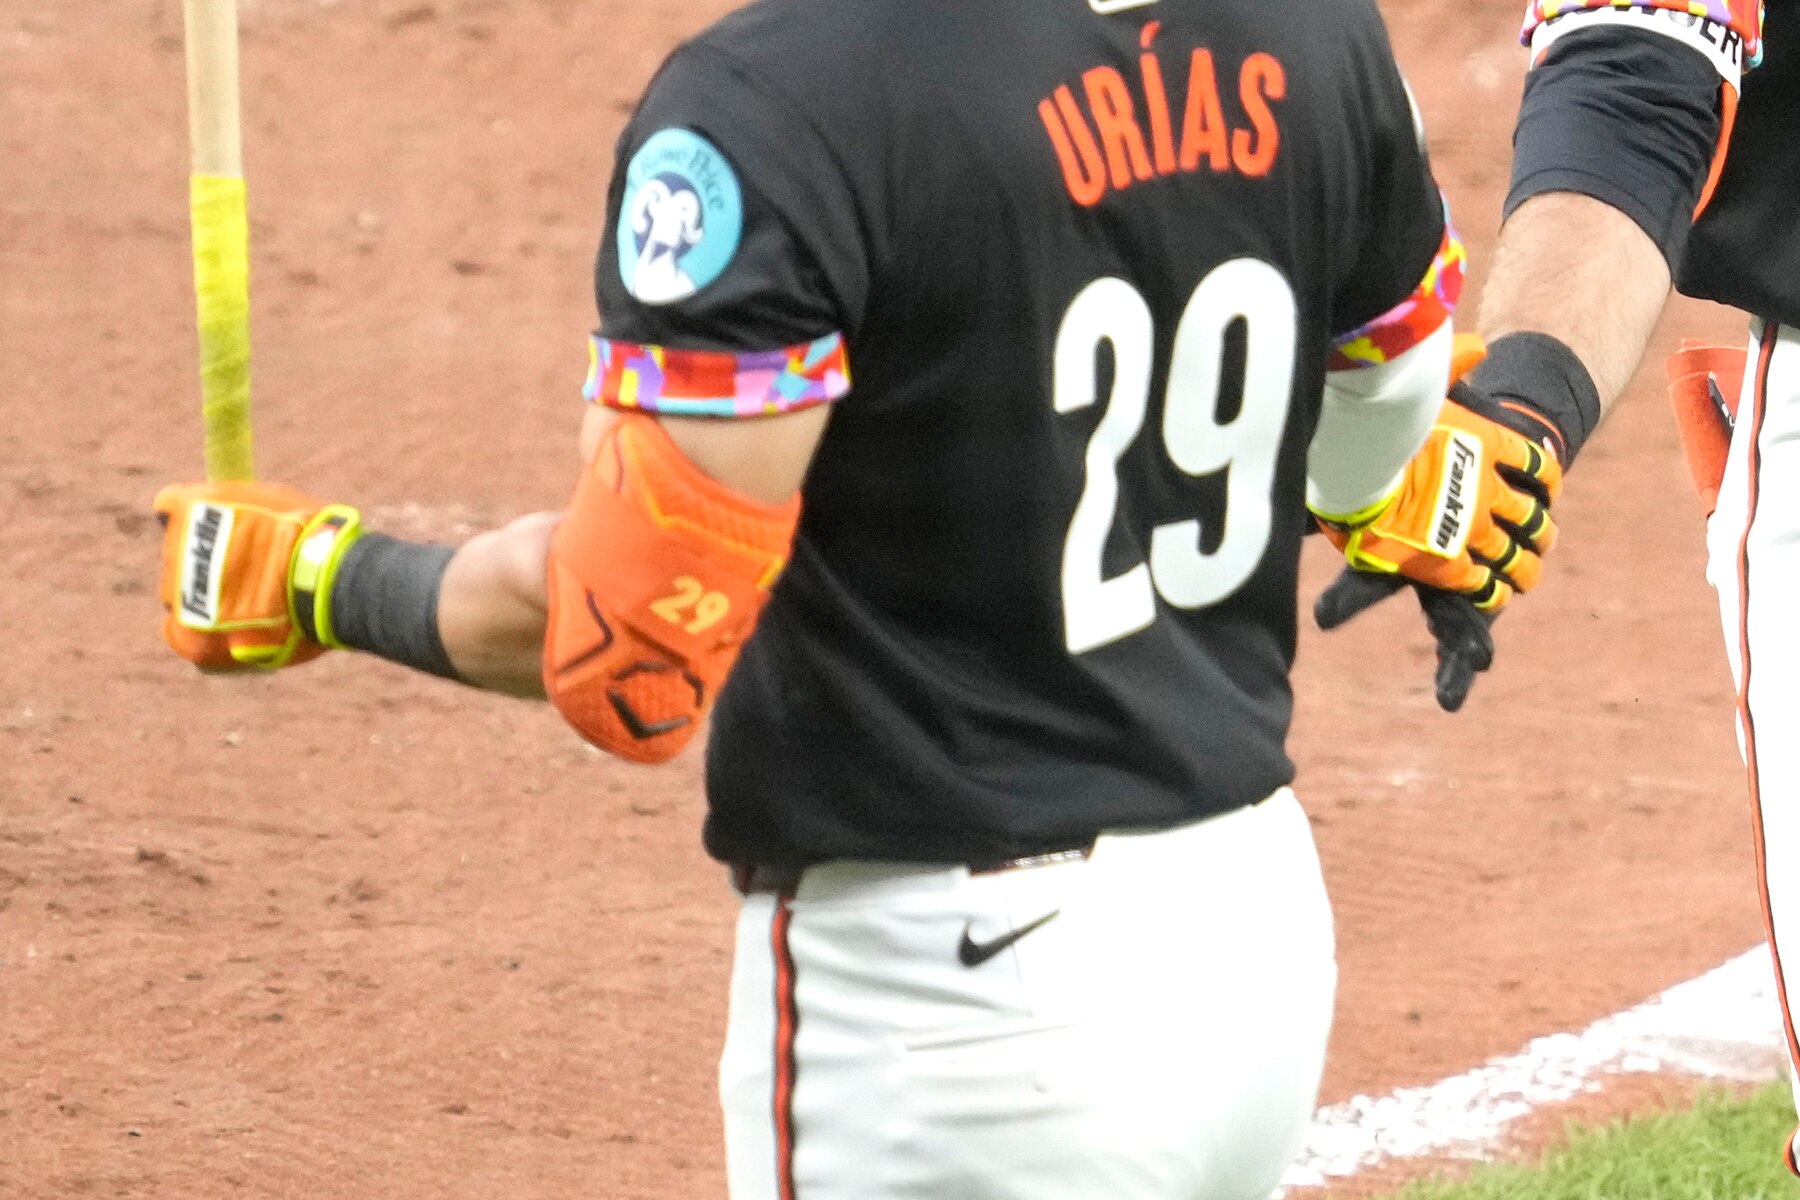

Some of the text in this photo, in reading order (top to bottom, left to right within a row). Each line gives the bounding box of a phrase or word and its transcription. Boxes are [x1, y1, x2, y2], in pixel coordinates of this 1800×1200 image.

[1037, 19, 1287, 208] URÍAS
[1053, 257, 1298, 656] 29
[650, 575, 730, 634] 29
